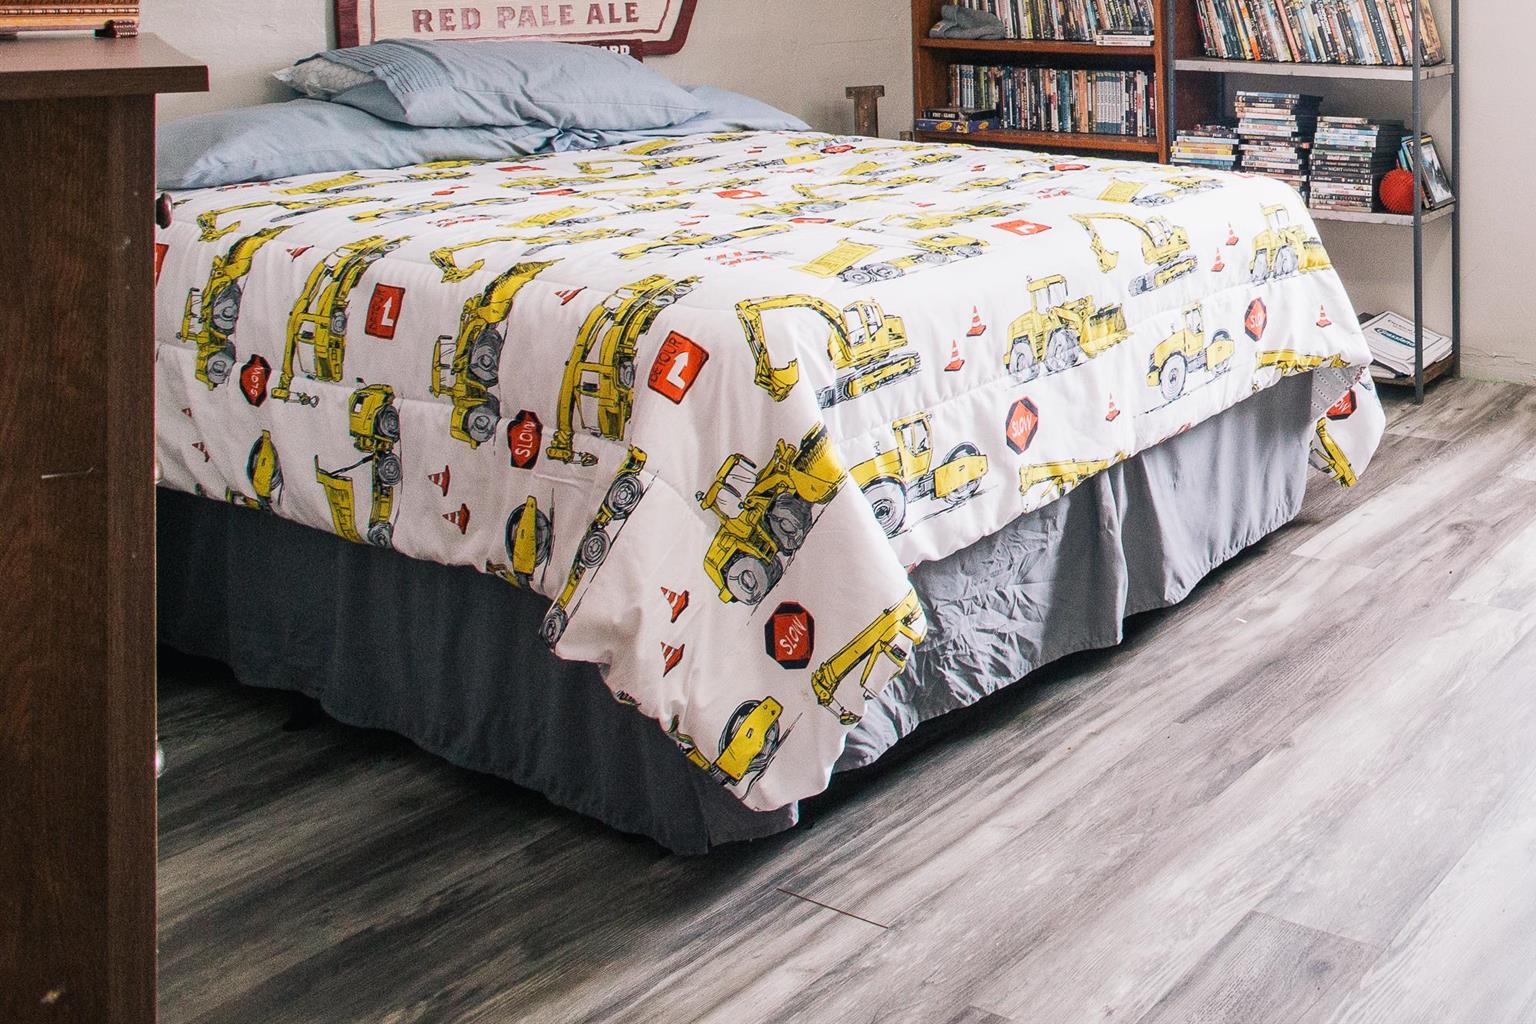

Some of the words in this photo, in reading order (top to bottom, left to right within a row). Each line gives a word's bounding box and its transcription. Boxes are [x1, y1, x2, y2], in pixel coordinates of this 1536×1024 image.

[412, 7, 481, 33] RED
[497, 4, 575, 30] PALE
[586, 2, 640, 25] ALE
[649, 337, 682, 384] DETOUR
[250, 366, 264, 397] SLOW
[515, 421, 535, 458] SLOW
[780, 615, 807, 655] SLOW
